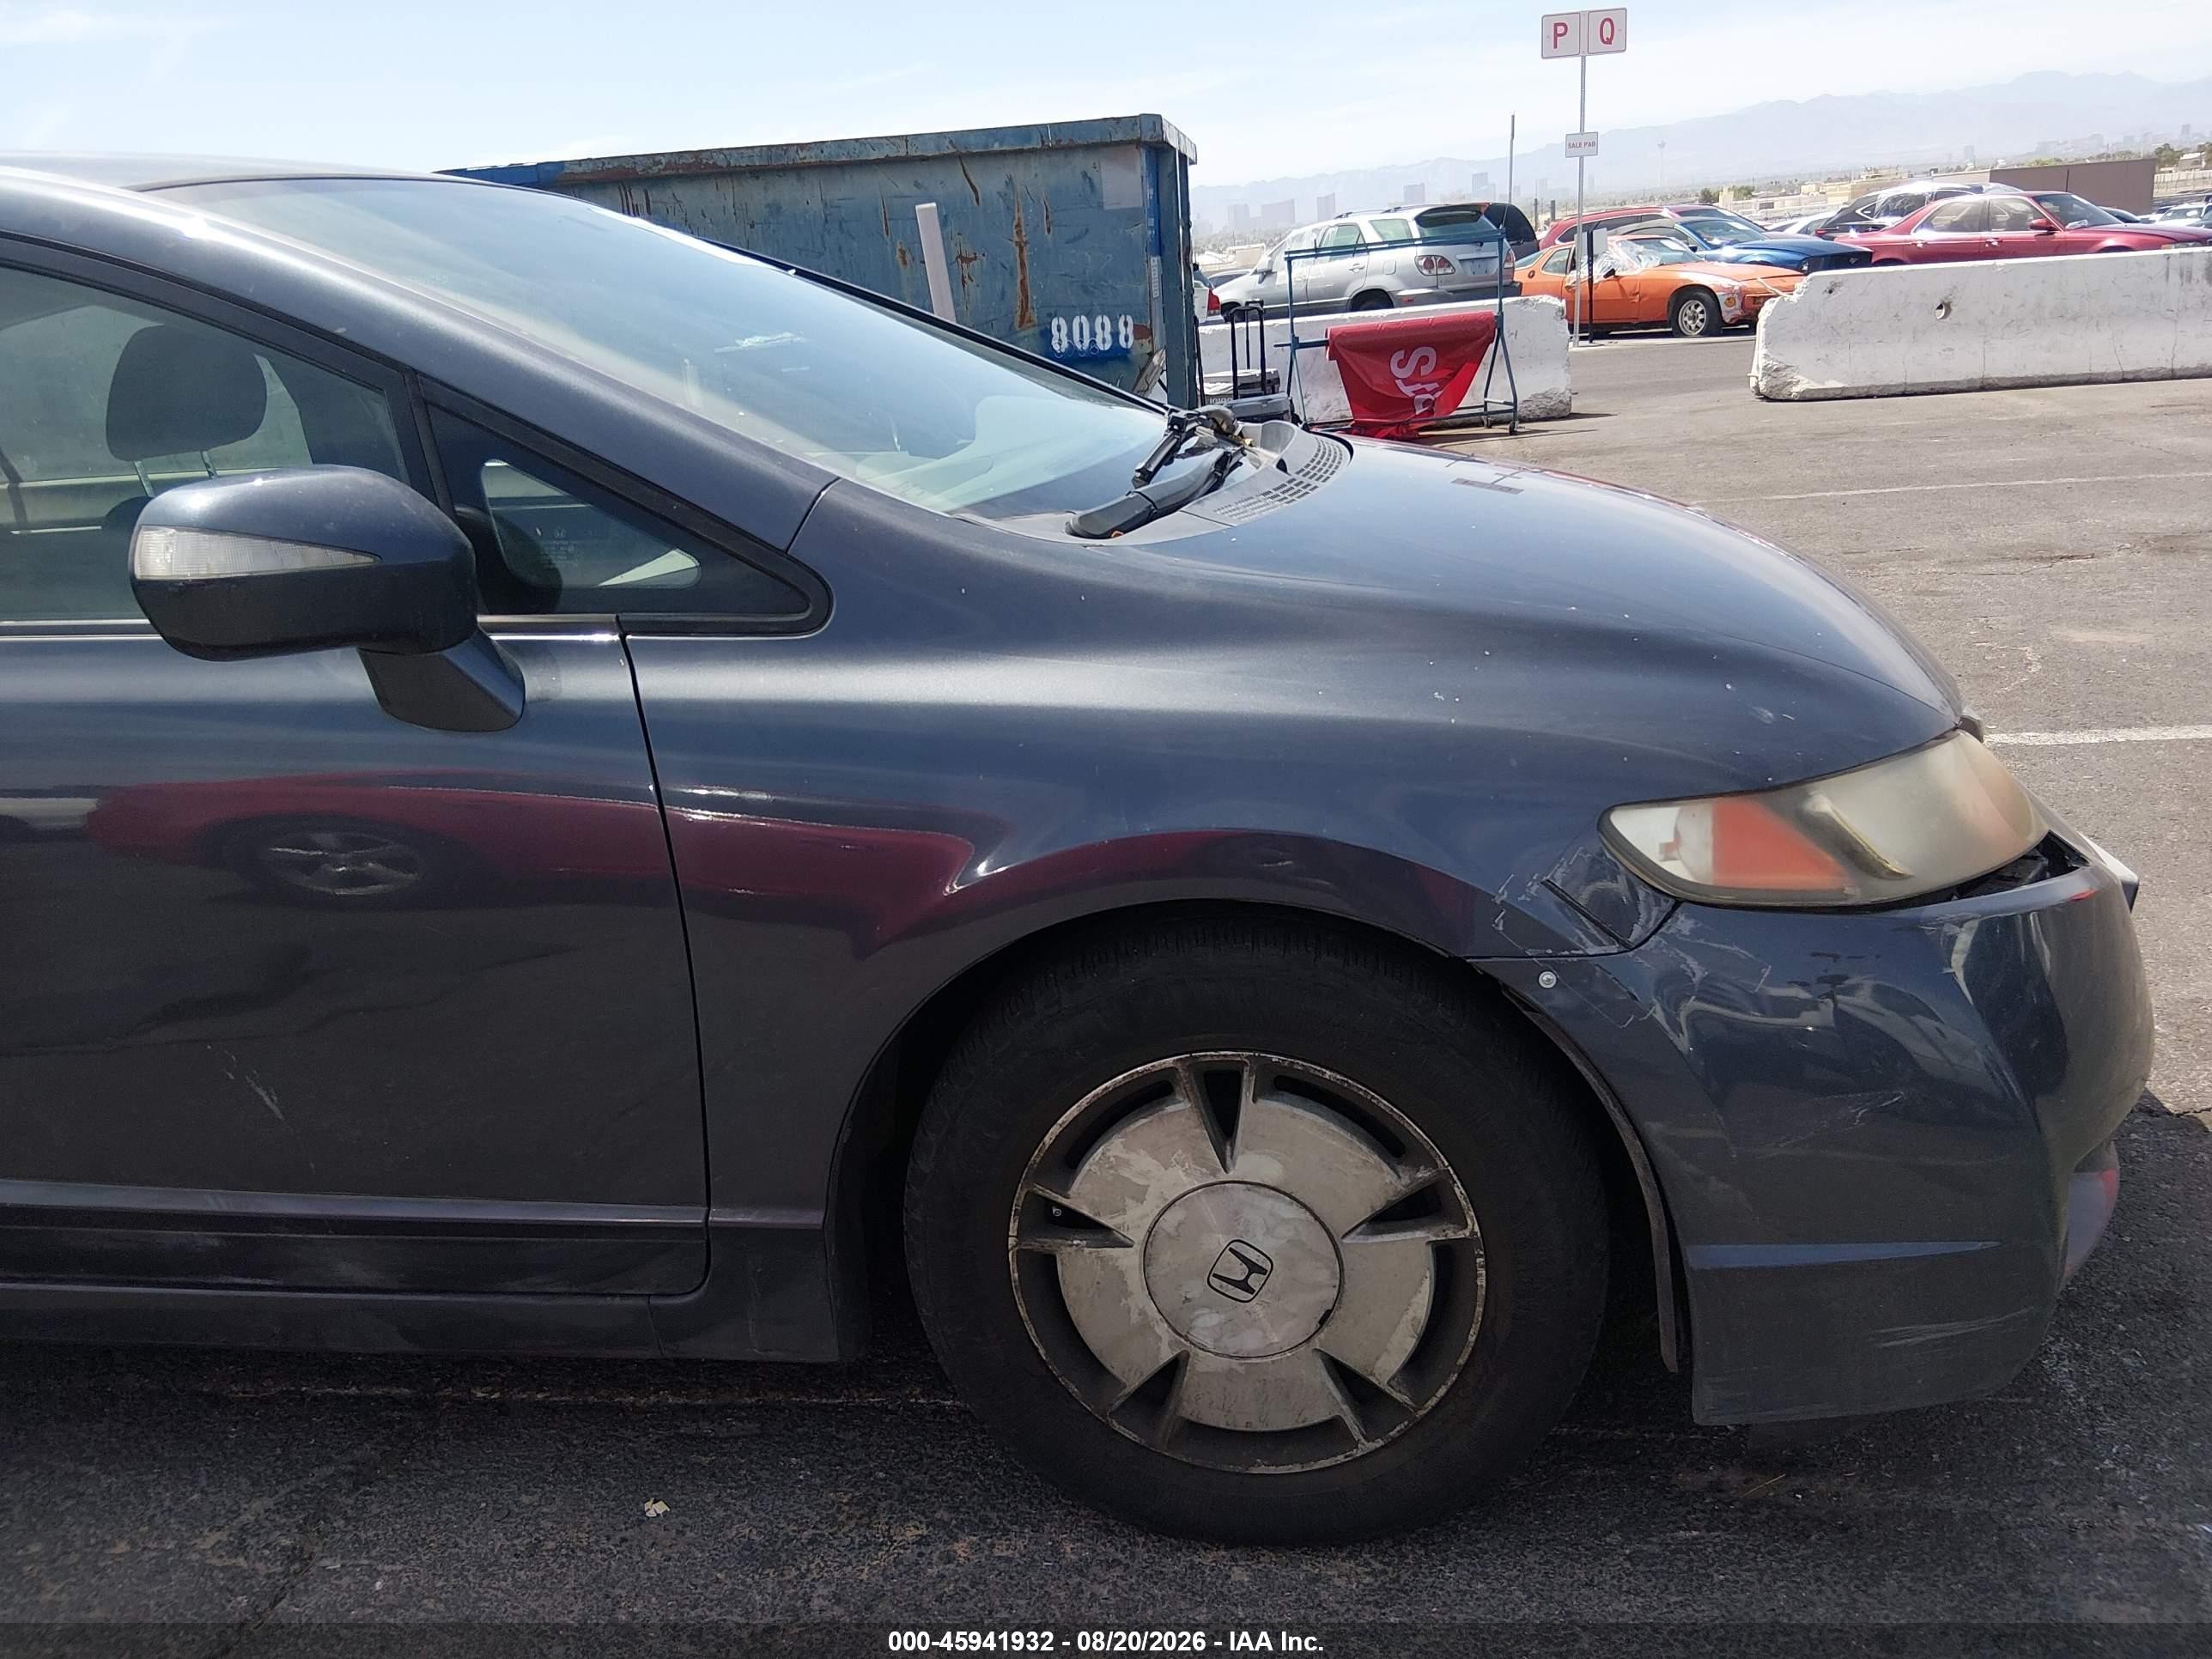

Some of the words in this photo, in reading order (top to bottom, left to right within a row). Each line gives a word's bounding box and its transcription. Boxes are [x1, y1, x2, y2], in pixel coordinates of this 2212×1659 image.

[1553, 22, 1568, 49] P
[1599, 17, 1614, 45] Q
[1051, 314, 1134, 353] 8088
